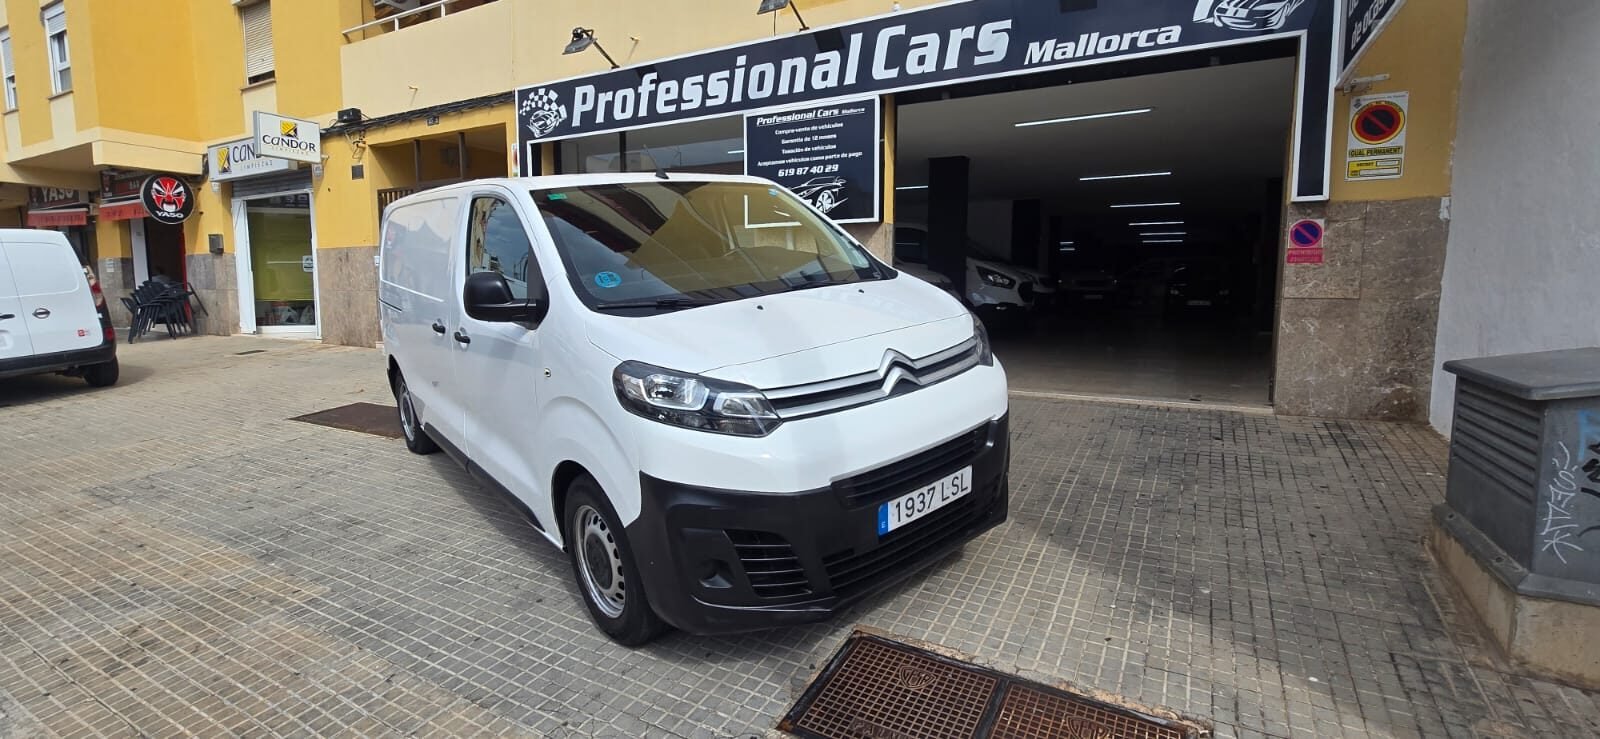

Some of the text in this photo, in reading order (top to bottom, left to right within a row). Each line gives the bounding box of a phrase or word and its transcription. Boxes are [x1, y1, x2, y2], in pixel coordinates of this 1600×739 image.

[571, 19, 1182, 127] Professional Cars Mallorca
[757, 110, 816, 126] Professional
[817, 108, 839, 117] Cars
[778, 164, 839, 177] 619 87 40 29
[41, 187, 74, 202] YASO
[155, 210, 185, 219] YASO
[896, 473, 968, 522] 1937 LSL
